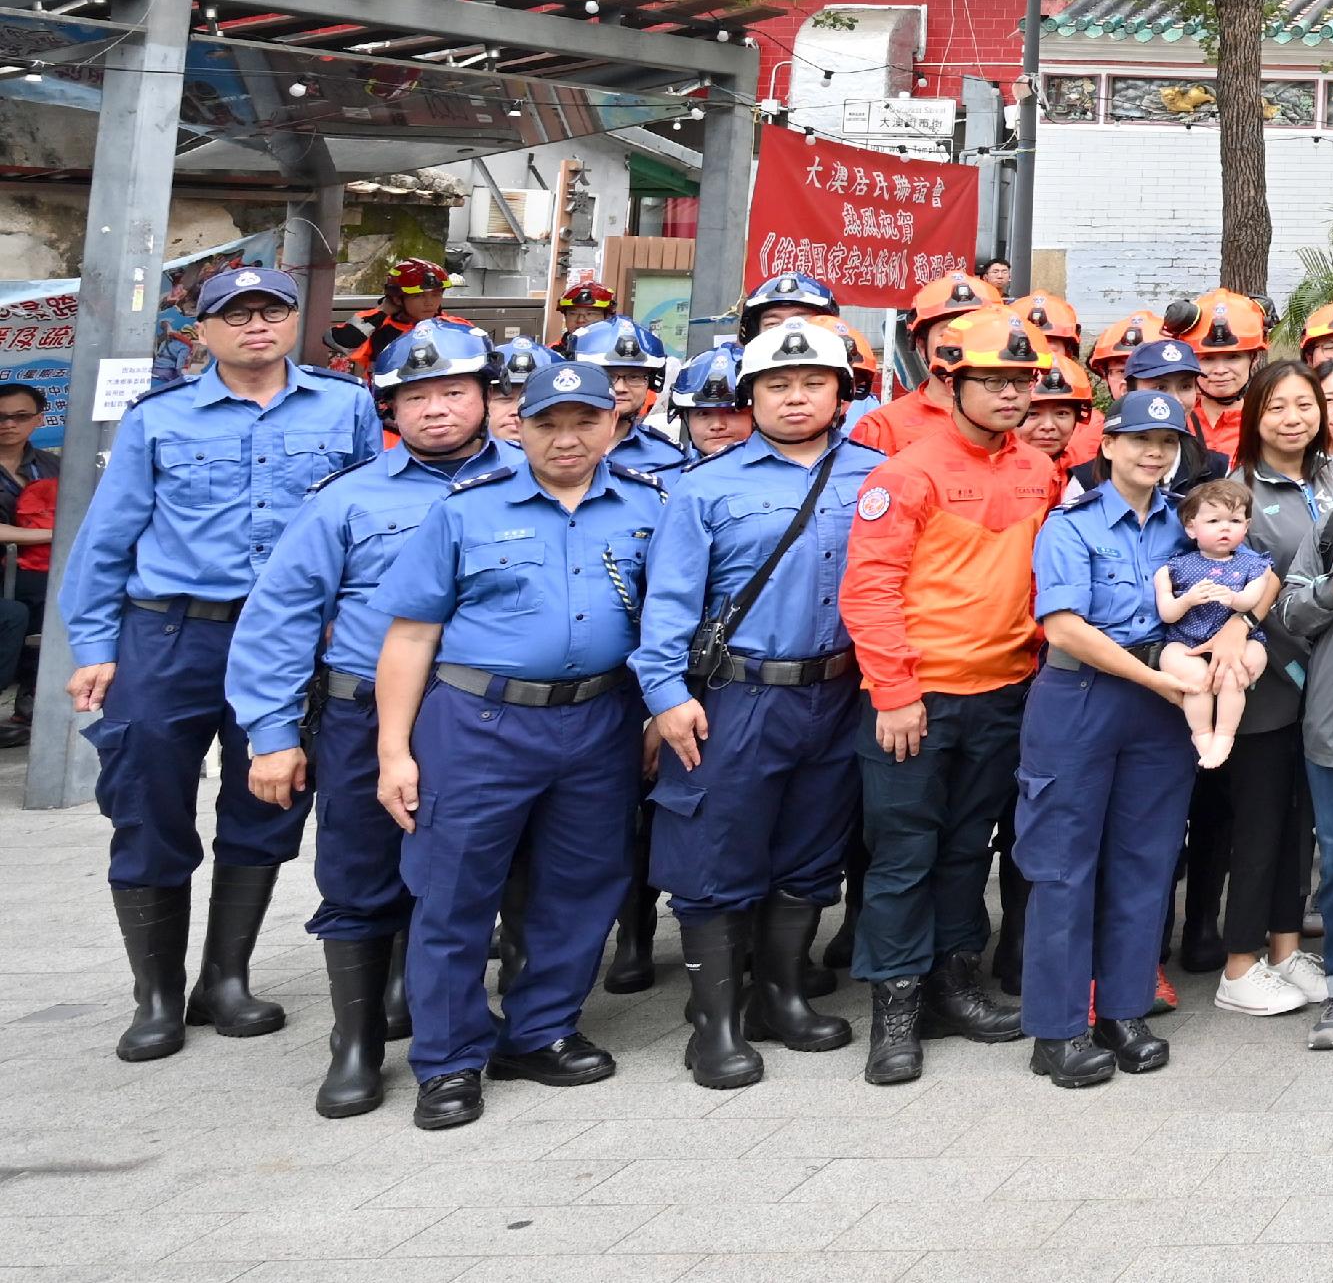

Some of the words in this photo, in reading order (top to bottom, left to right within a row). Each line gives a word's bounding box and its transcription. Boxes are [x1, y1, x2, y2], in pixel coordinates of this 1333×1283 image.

[806, 155, 945, 208] 大澳居民聯誼會
